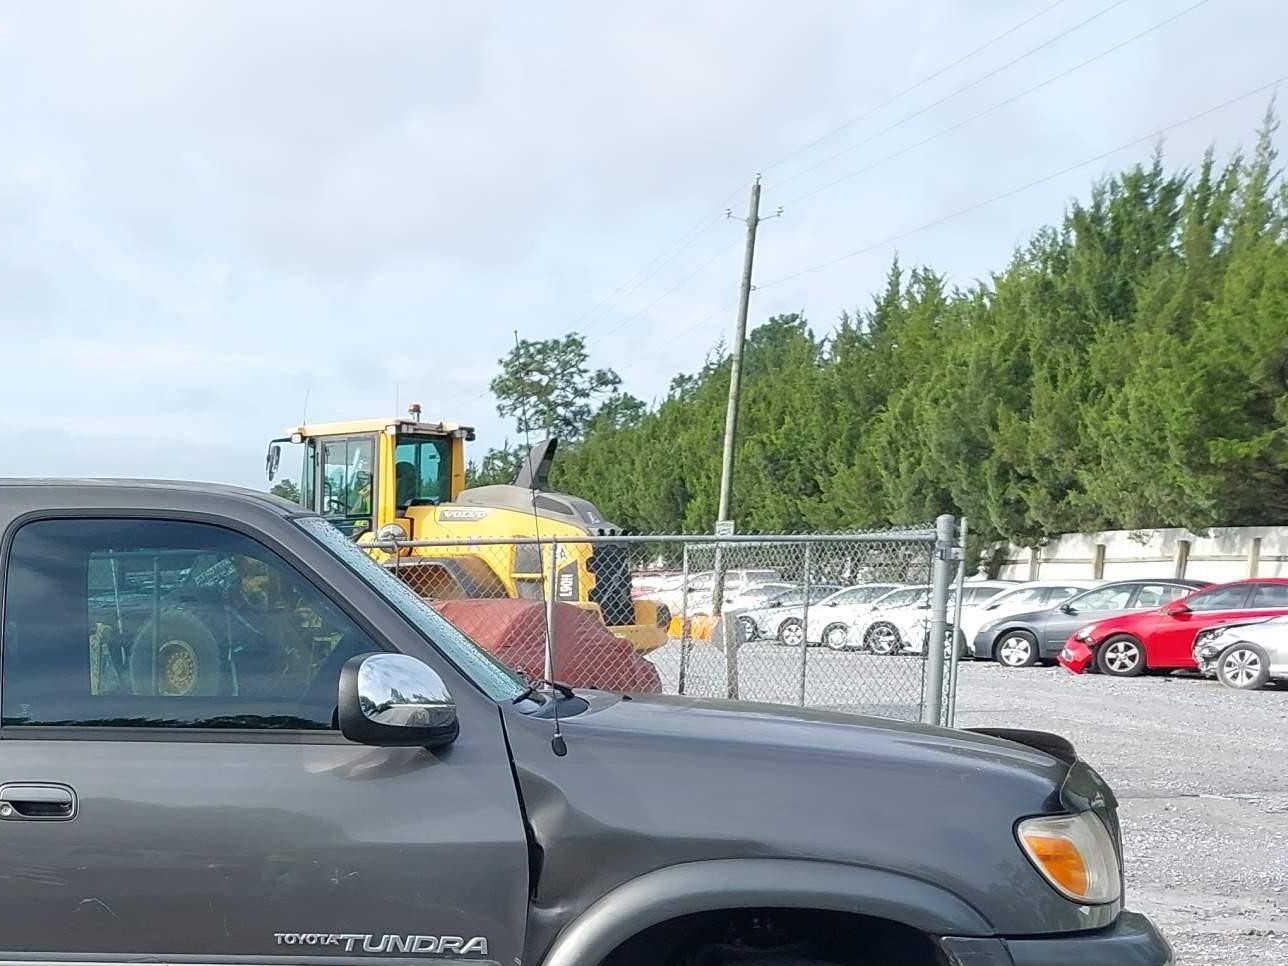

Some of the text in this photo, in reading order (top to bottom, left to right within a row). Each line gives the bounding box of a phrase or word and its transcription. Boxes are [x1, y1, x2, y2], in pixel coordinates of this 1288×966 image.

[443, 510, 486, 519] VOLVO
[274, 933, 488, 955] TOYOTA TUNDRA
